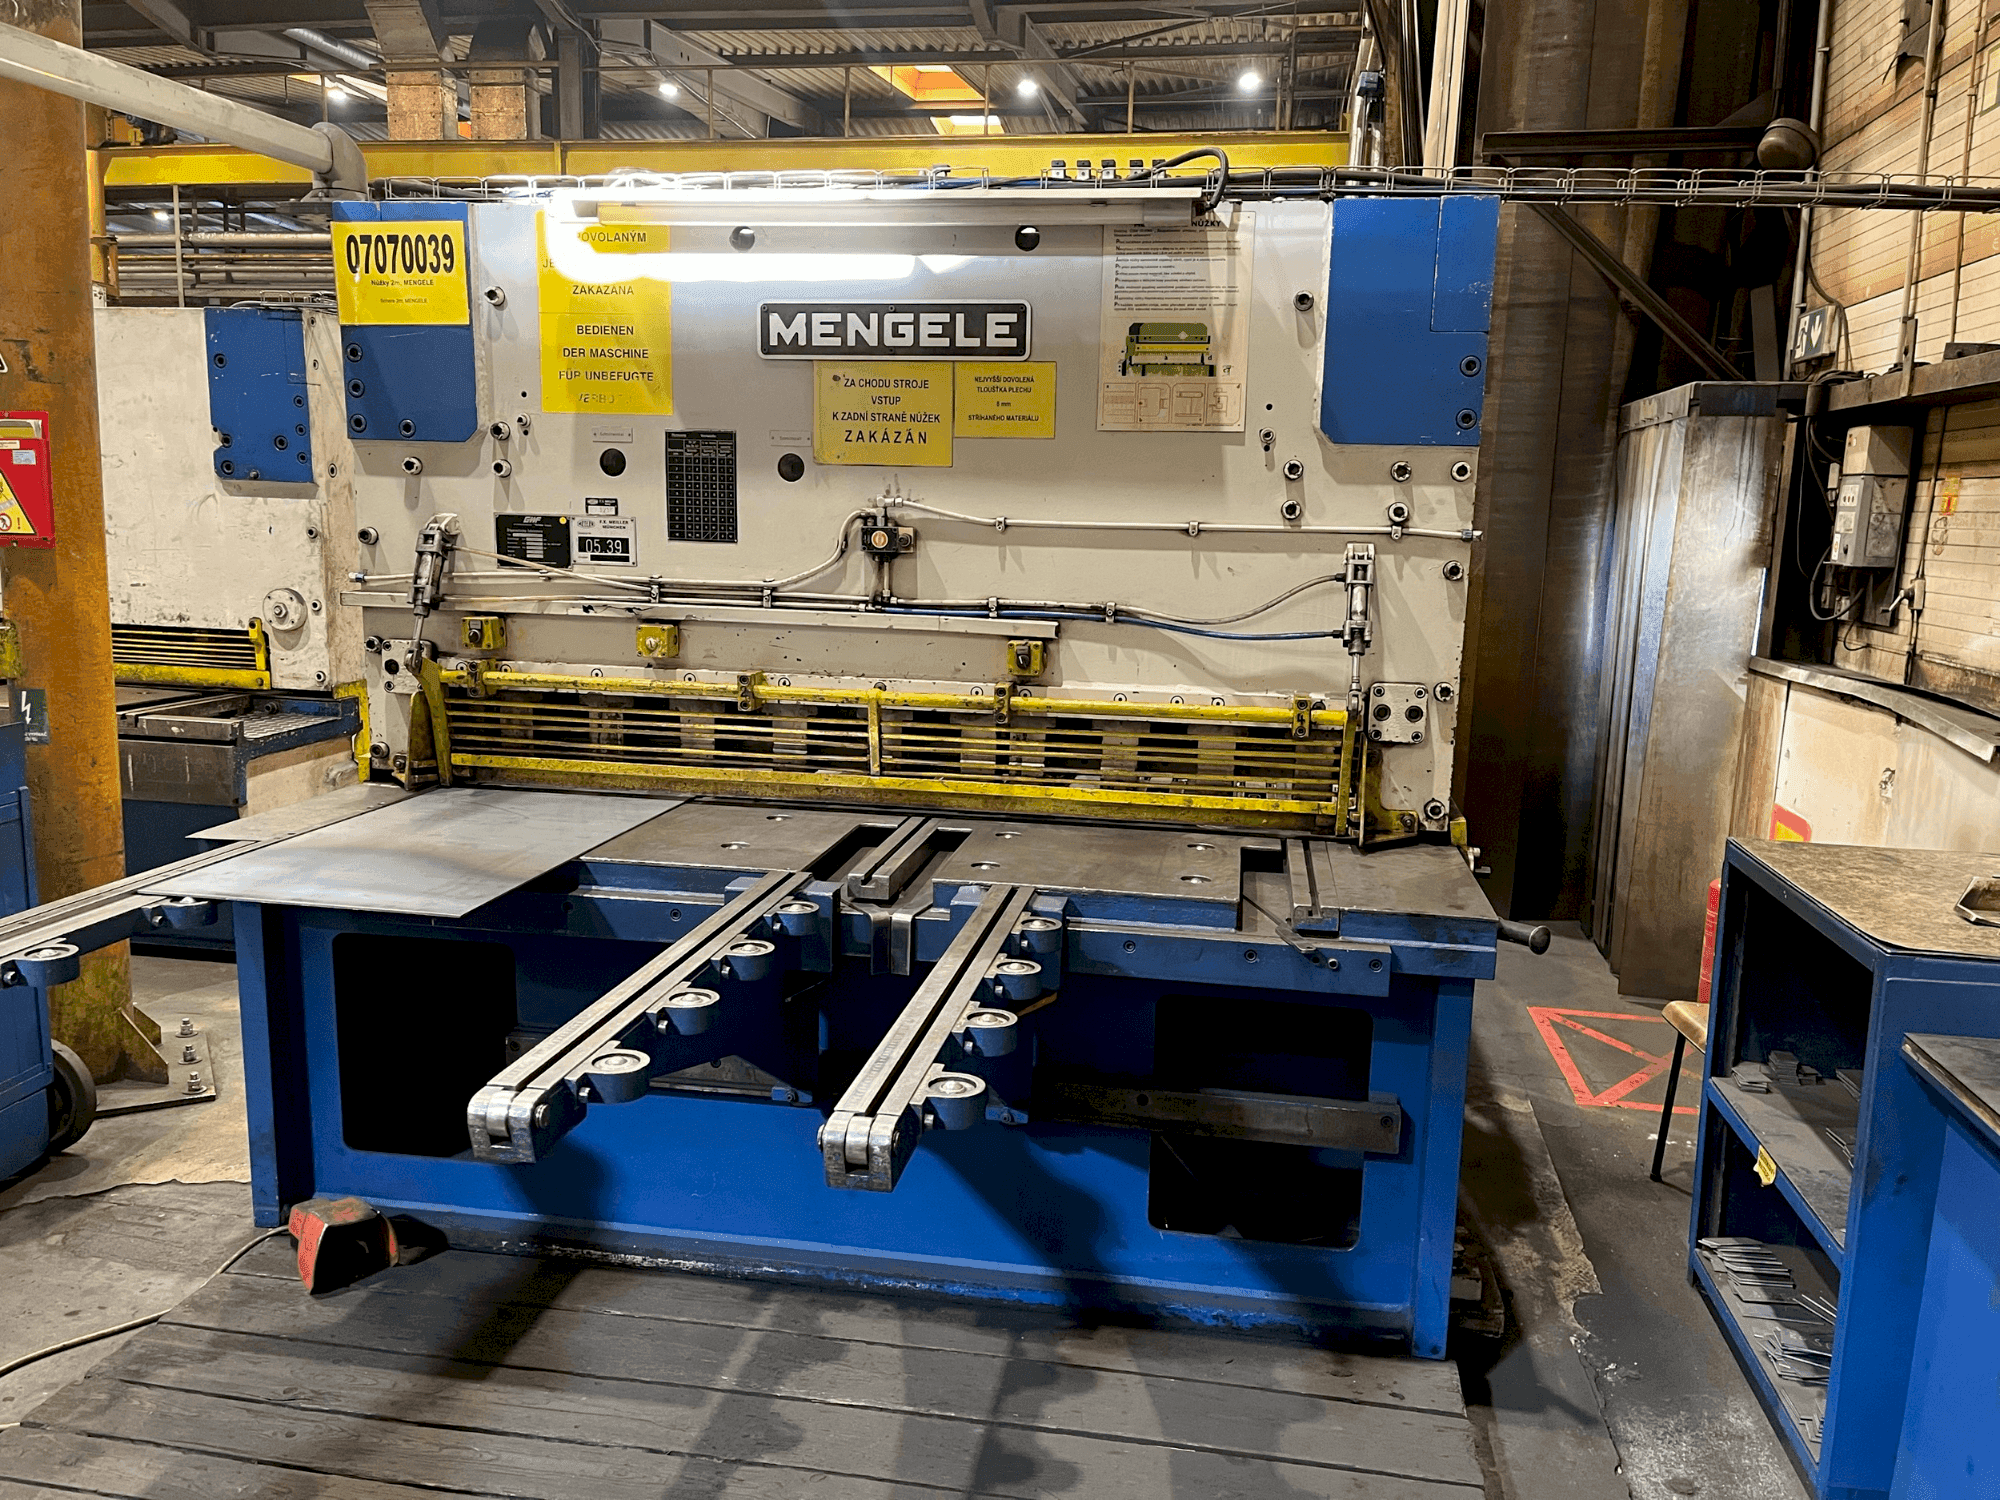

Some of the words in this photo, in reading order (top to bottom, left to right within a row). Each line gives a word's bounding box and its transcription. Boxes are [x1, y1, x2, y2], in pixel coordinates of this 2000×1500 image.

[346, 234, 454, 274] 07070039
[576, 325, 634, 335] BEDIENEN
[769, 312, 1018, 347] MENGELE
[562, 347, 586, 358] DER
[589, 348, 649, 359] MASCHINE
[558, 368, 581, 380] FÜR
[585, 371, 654, 381] UNBEFUGTE
[844, 378, 856, 387] ZA
[858, 378, 890, 388] CHODU
[893, 379, 929, 389] STROJE
[871, 395, 901, 405] VSTUP
[832, 411, 839, 420] K
[841, 410, 868, 421] ZADNÍ
[870, 411, 907, 422] STRANĚ
[585, 539, 622, 554] 05.39
